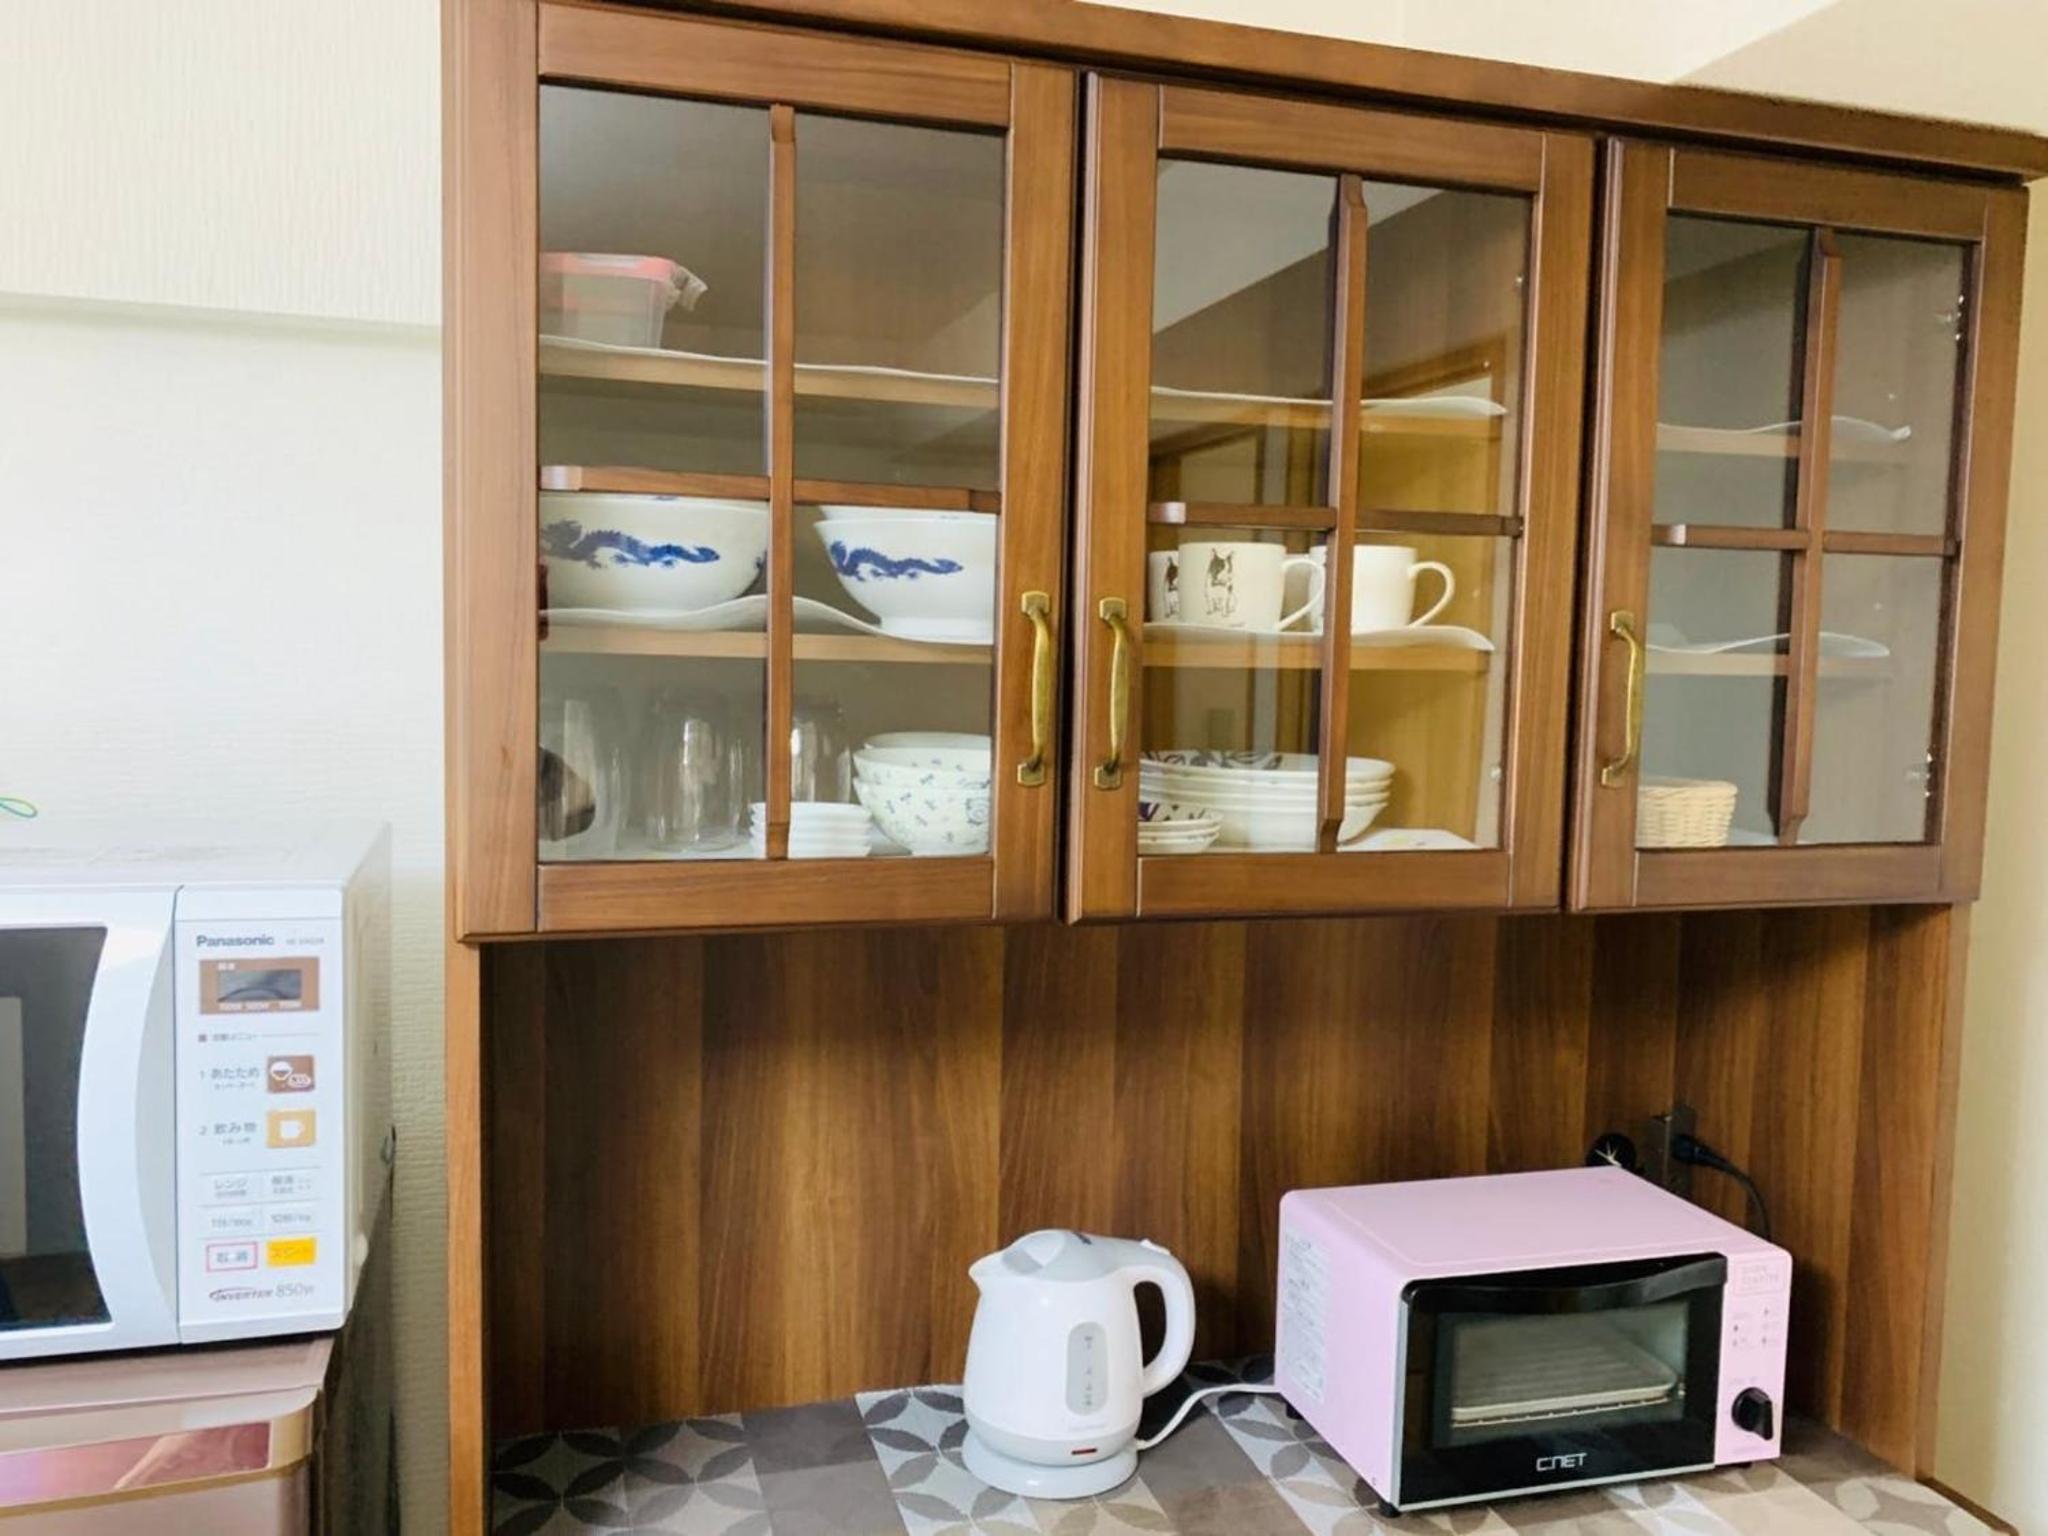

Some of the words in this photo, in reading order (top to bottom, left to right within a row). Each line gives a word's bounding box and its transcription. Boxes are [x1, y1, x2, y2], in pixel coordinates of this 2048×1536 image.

[196, 934, 275, 947] Panasonic
[211, 1067, 260, 1080] あたため
